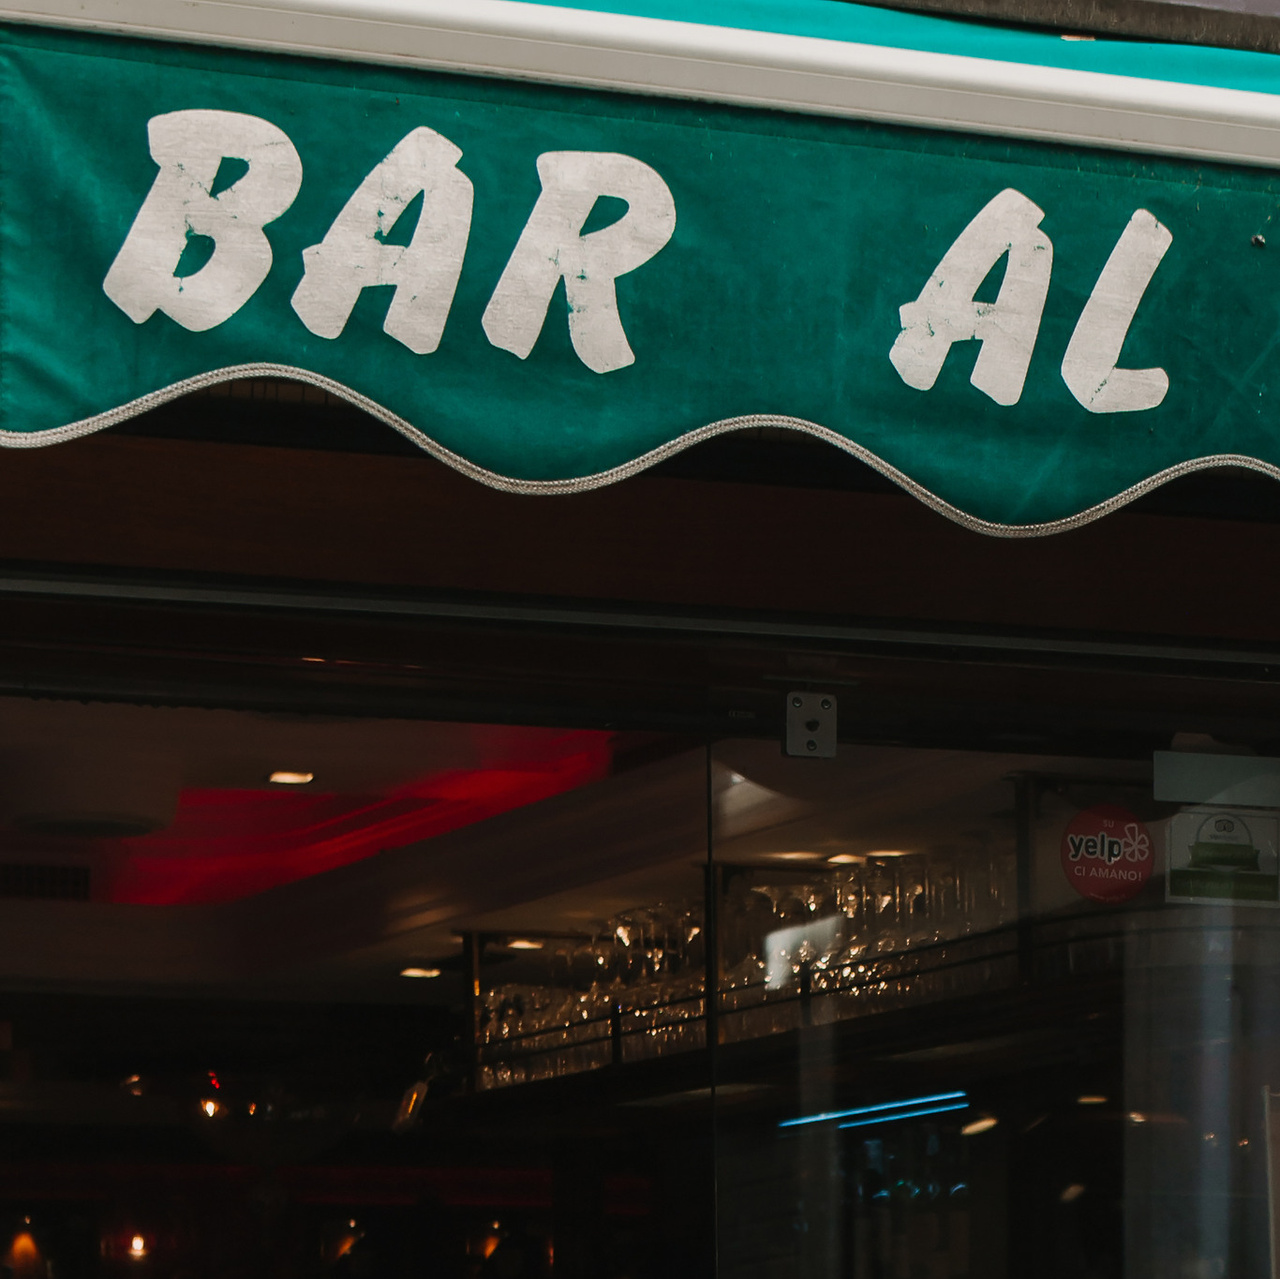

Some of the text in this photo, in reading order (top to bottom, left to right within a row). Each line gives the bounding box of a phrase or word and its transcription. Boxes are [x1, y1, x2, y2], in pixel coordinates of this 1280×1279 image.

[103, 108, 677, 374] BAR
[888, 187, 1174, 414] AL
[1068, 832, 1122, 864] yelp
[1074, 866, 1142, 882] CI AMANO!
